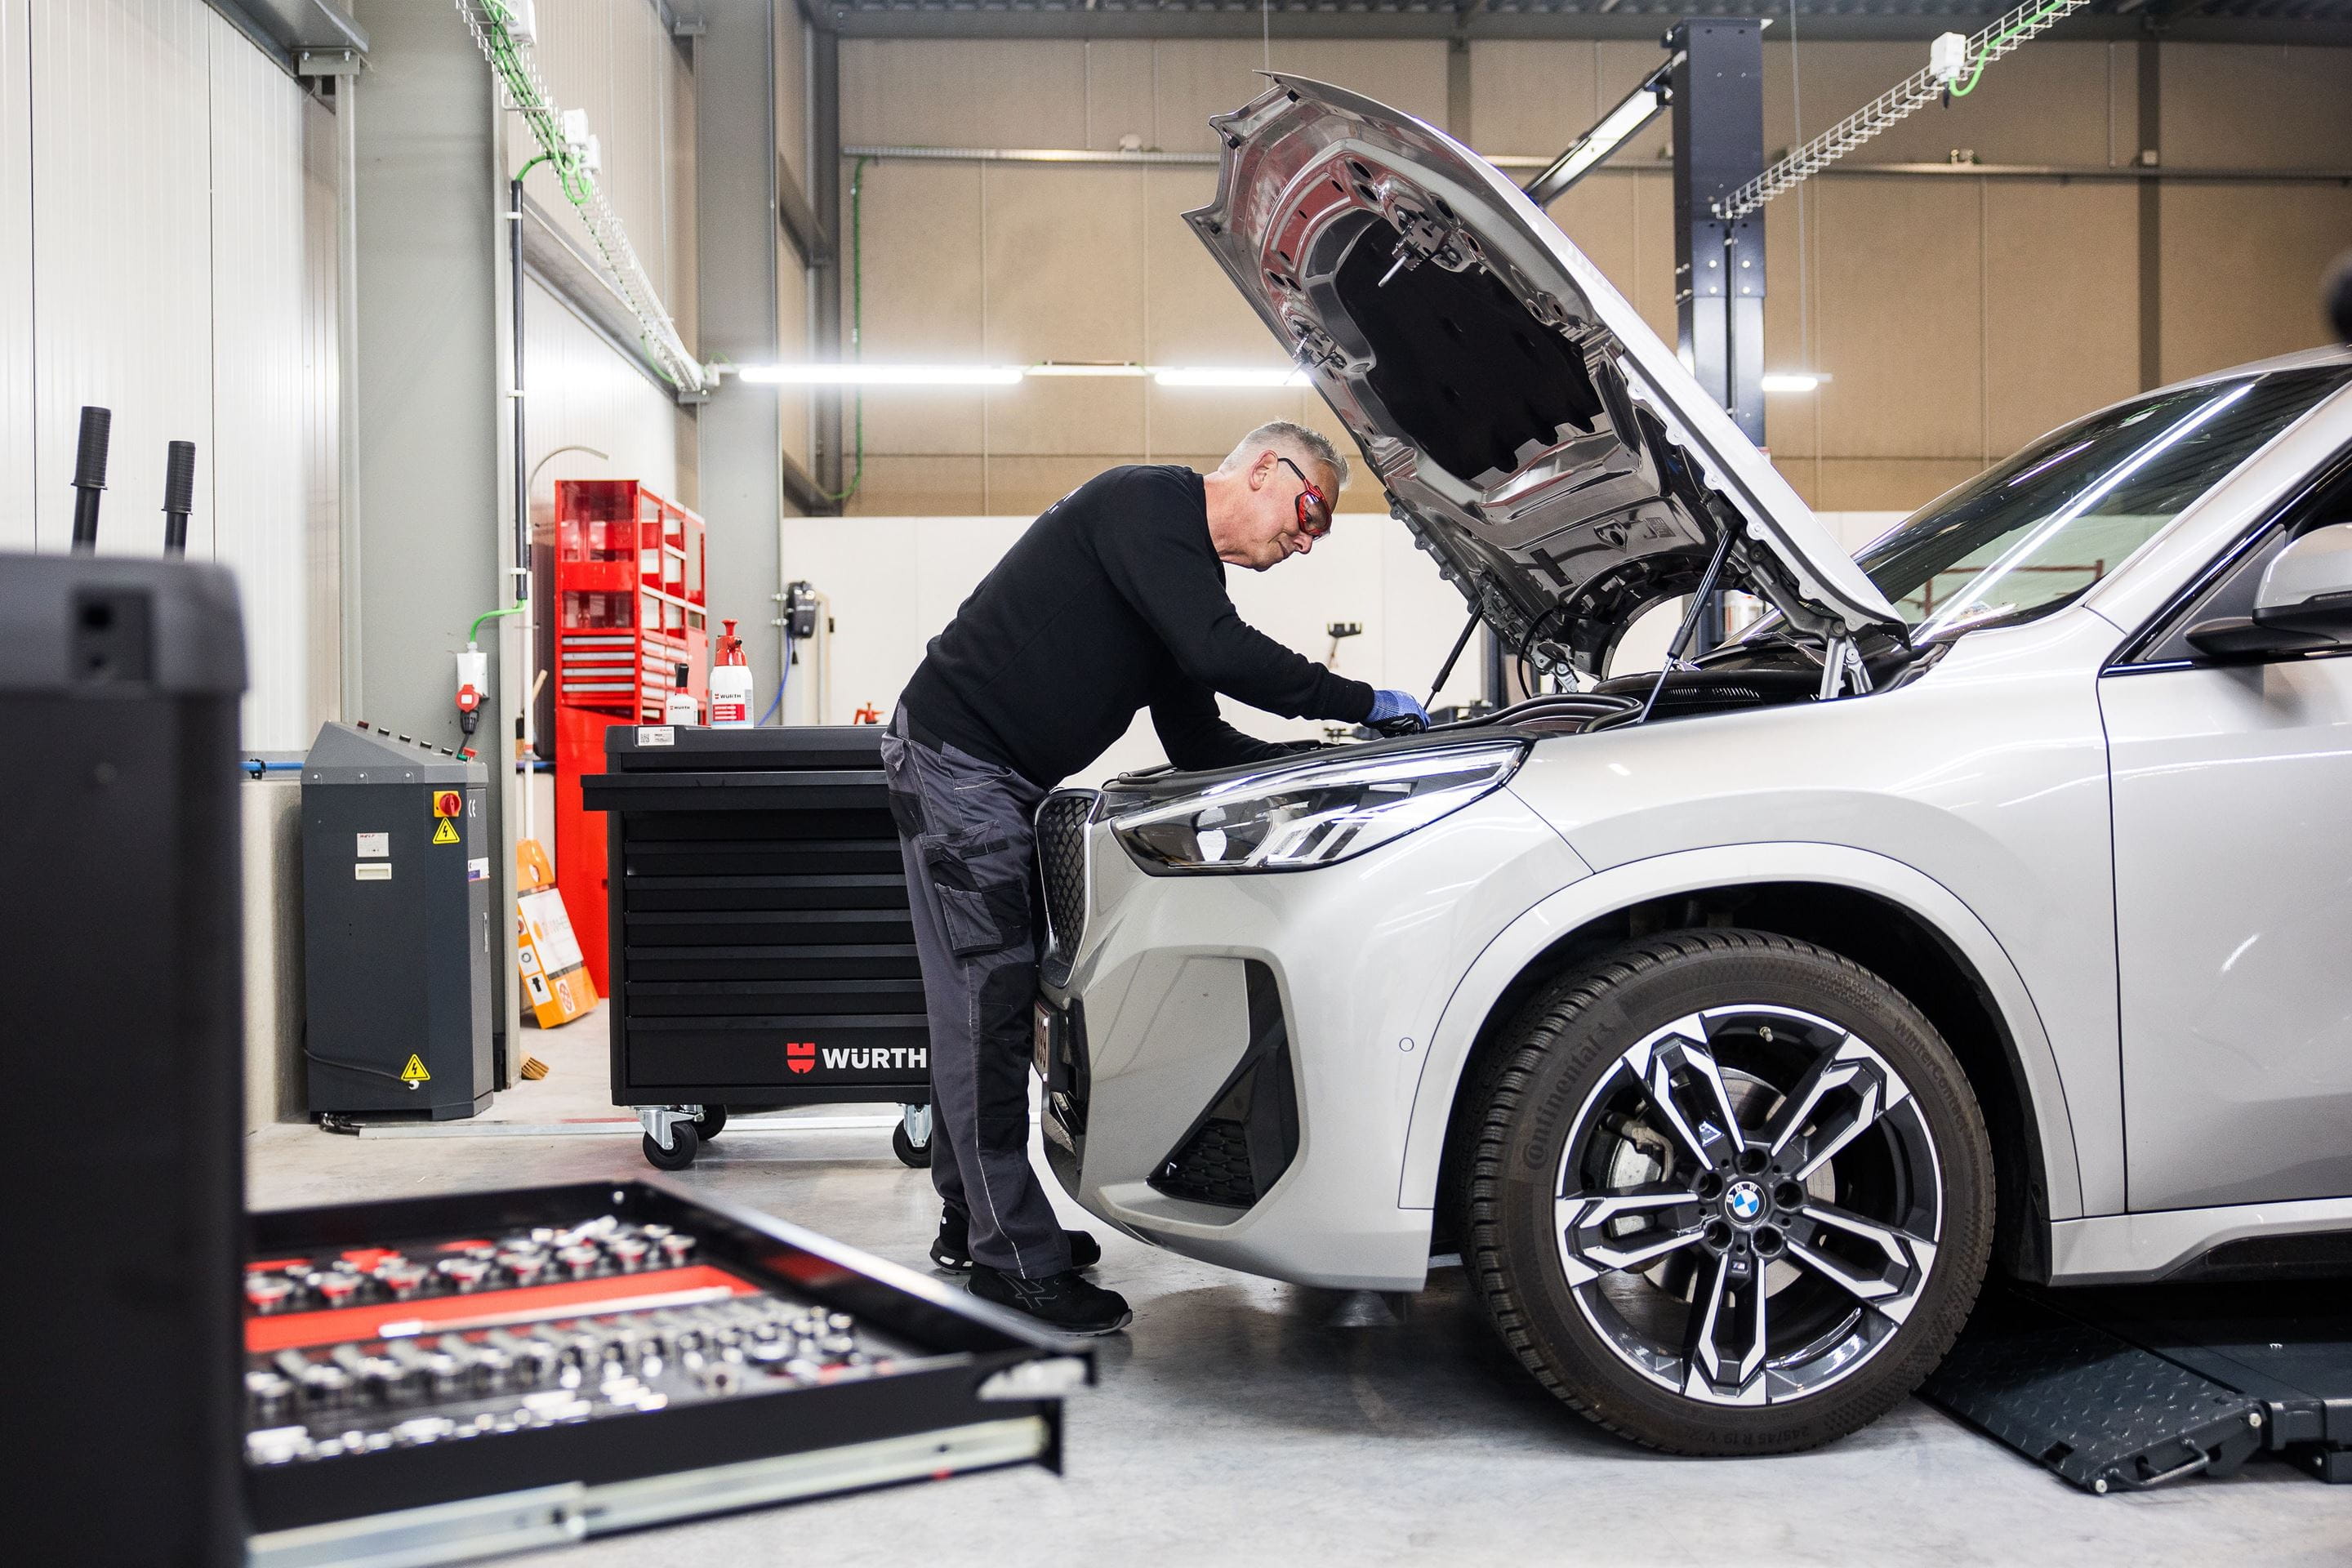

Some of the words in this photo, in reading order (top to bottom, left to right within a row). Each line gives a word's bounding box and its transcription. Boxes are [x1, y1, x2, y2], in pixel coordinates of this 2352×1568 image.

[822, 1048, 927, 1069] WÜRTH
[1894, 1020, 1967, 1133] WinterContact
[1522, 1033, 1604, 1170] Continental
[1726, 1183, 1757, 1204] BMW
